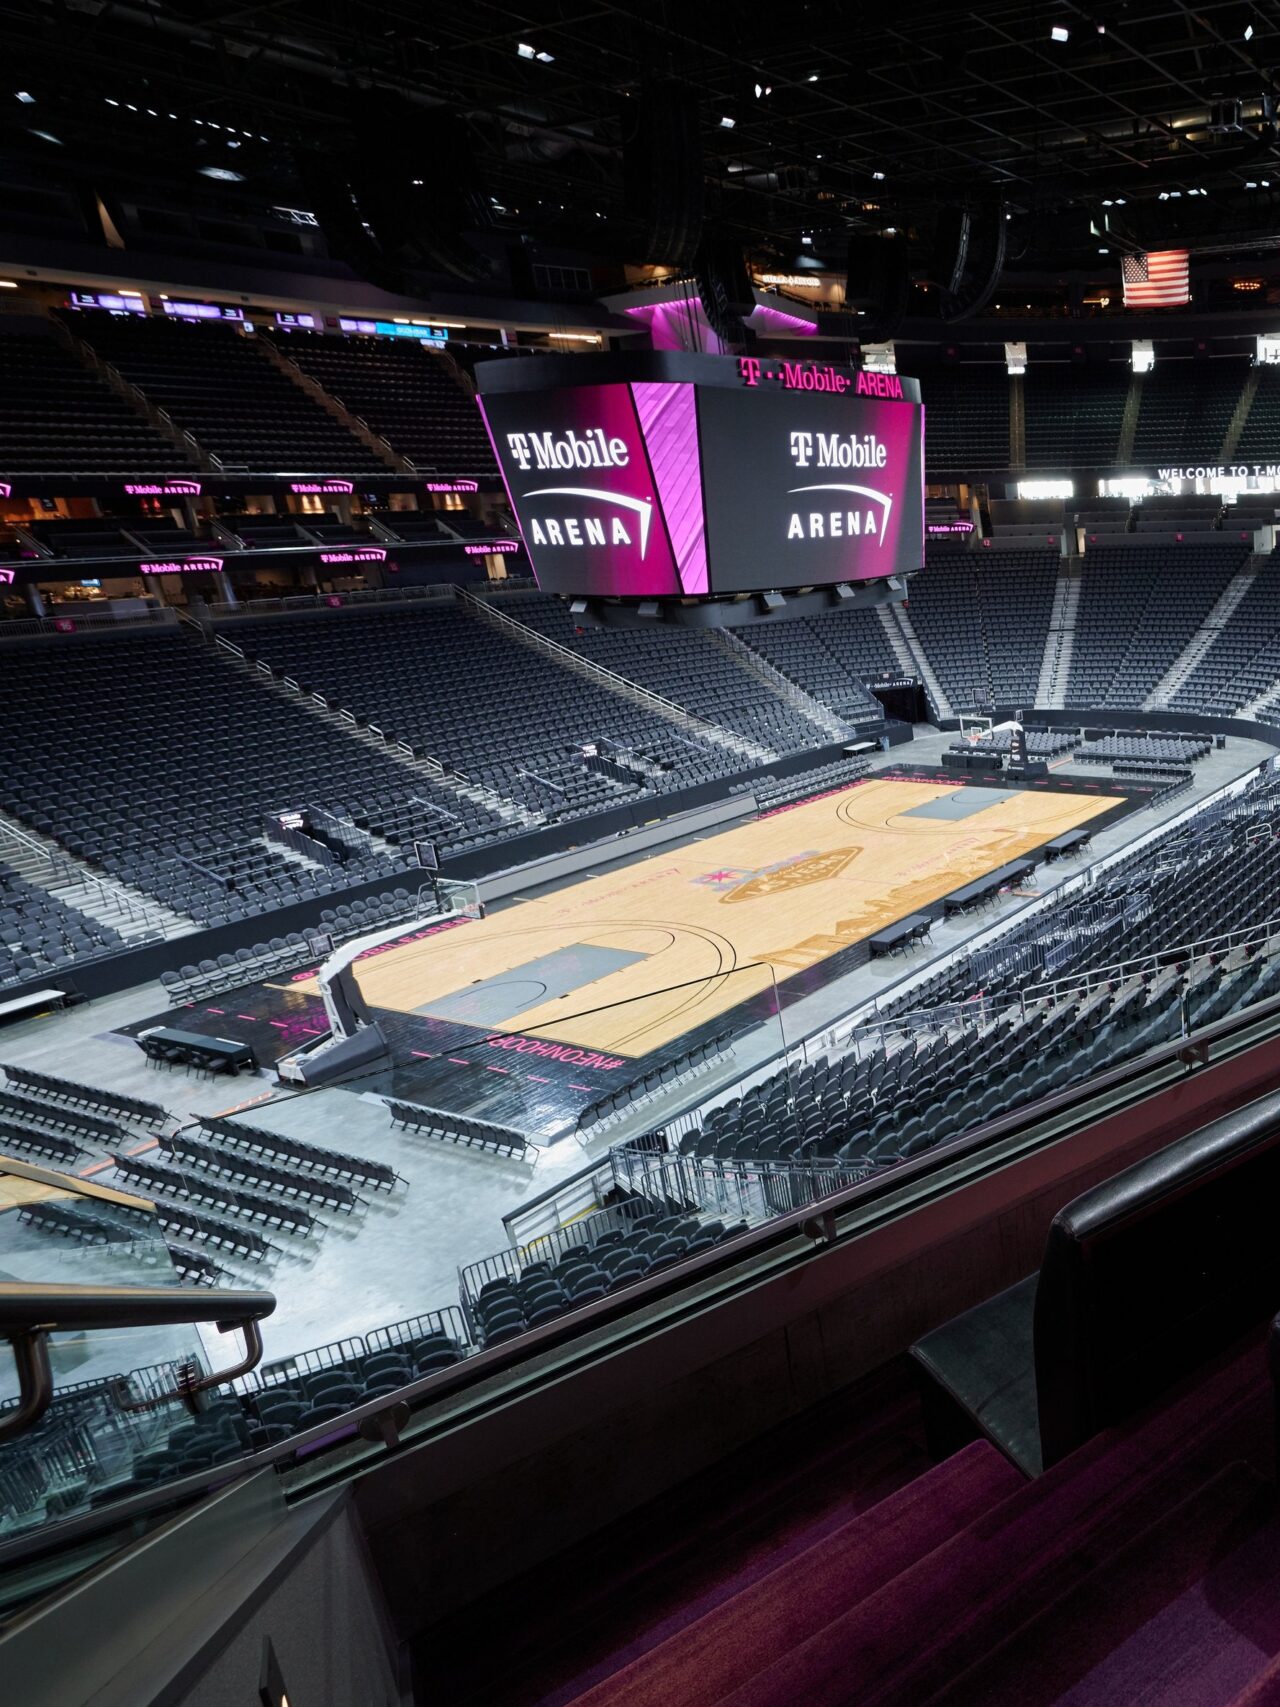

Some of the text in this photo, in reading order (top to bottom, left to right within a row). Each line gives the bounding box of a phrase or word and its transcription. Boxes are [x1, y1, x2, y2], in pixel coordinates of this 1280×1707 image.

[856, 371, 904, 399] ARENA
[1158, 467, 1225, 480] WELCOME
[1230, 465, 1249, 477] TO
[164, 486, 196, 494] ARENA
[323, 485, 349, 493] ARENA
[787, 510, 877, 539] ARENA
[531, 517, 632, 546] ARENA
[354, 553, 382, 561] ARENA
[183, 562, 218, 572] ARENA
